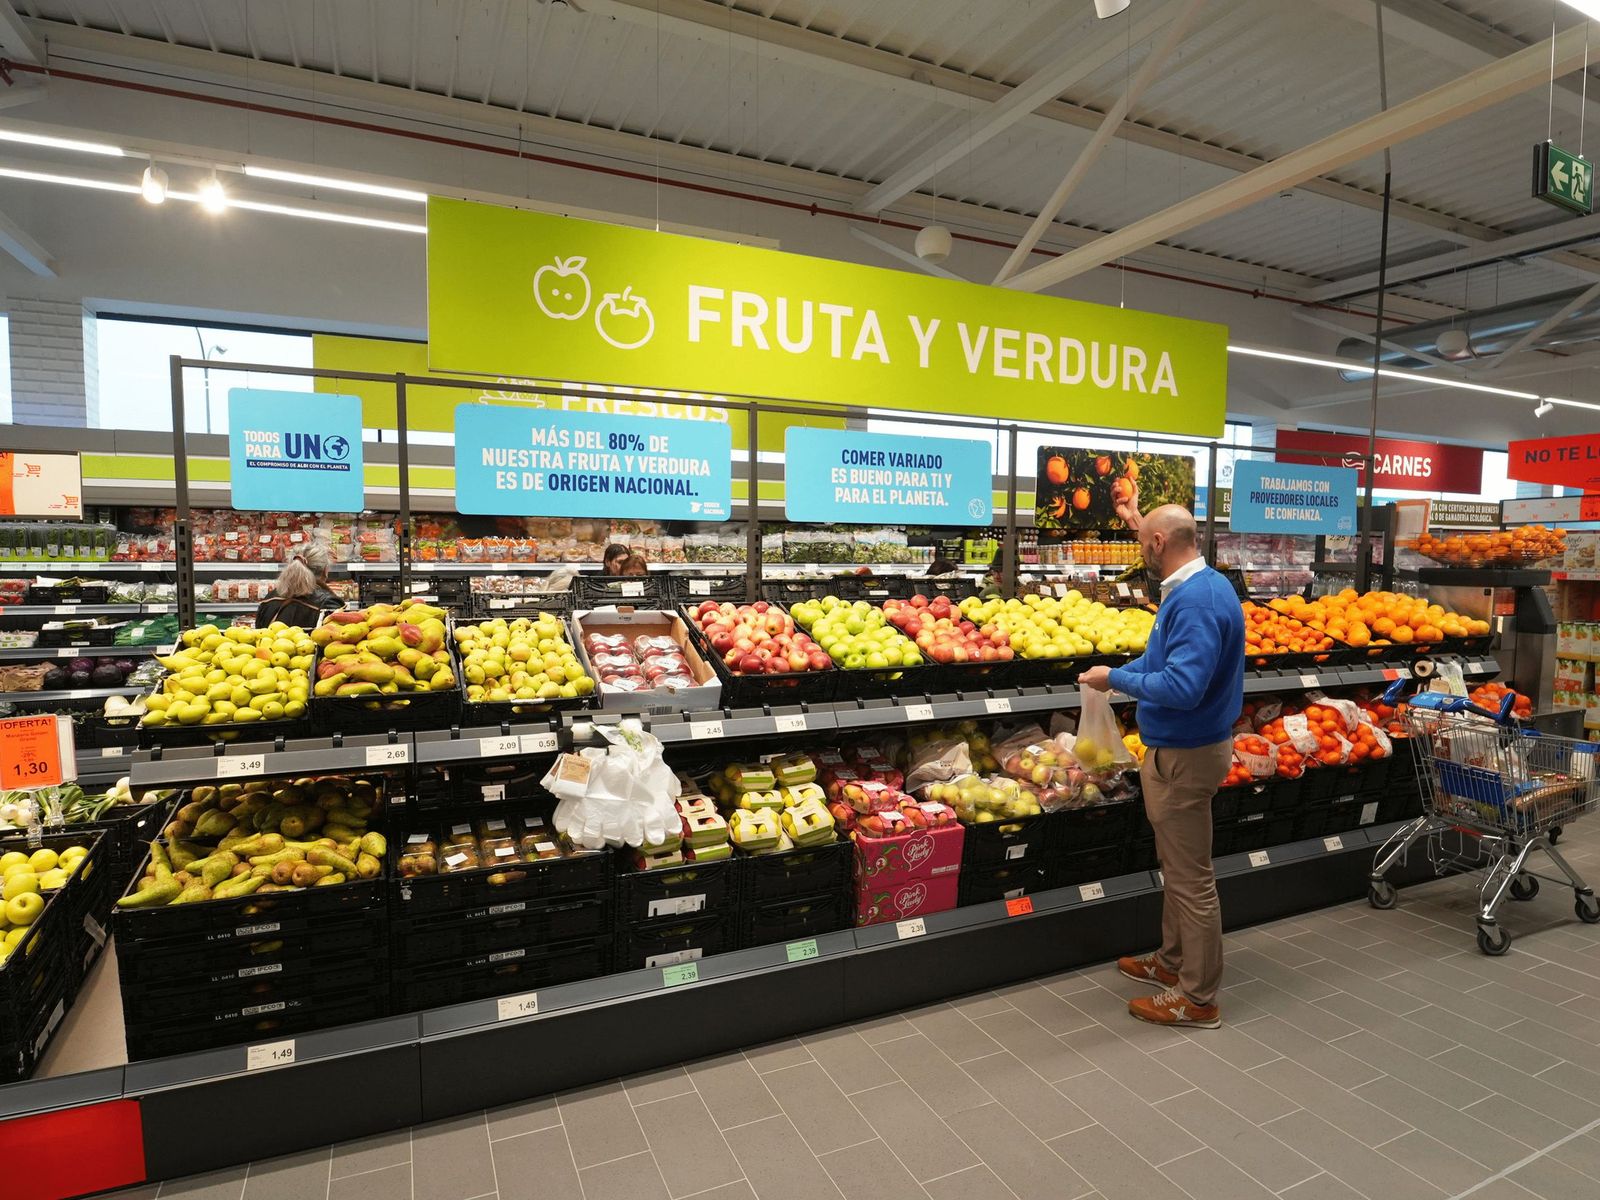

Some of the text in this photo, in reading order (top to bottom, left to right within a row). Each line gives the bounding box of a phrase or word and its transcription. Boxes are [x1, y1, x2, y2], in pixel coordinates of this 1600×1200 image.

[687, 283, 1179, 397] FRUTA Y VERDURA
[561, 381, 729, 422] FRESCOS
[243, 430, 280, 443] TODOS
[531, 425, 669, 453] MÁS DEL 80% DE
[245, 444, 282, 458] PARA
[1525, 445, 1600, 464] NO TE L
[481, 448, 711, 477] NUESTRA FRUTA Y VERDURA
[842, 449, 943, 470] COMER VARIADO
[1373, 453, 1432, 477] CARNES
[496, 471, 699, 496] ES DE ORIGEN NACIONAL.
[831, 467, 952, 489] ES BUENO PARA TI Y
[1260, 476, 1330, 493] TRABAJAMOS CON
[834, 487, 949, 507] PARA EL PLANETA.
[1250, 491, 1339, 508] PROVEEDORES LOCALES
[1264, 507, 1323, 521] DE CONFIANZA.
[1438, 503, 1448, 512] CON
[1448, 503, 1475, 513] CERTIFICADO
[1475, 505, 1481, 513] DE
[1438, 512, 1445, 521] DE
[0, 718, 51, 730] ¡OFERTA!
[707, 727, 722, 735] 2,45
[499, 741, 517, 750] 2,09
[538, 739, 556, 748] 0,59
[387, 750, 406, 759] 2,69
[13, 761, 48, 777] 1,30
[240, 761, 261, 771] 3,49
[907, 839, 929, 856] Pink
[910, 846, 932, 862] Lady
[899, 886, 921, 904] Pink
[901, 894, 924, 911] Lady
[911, 923, 924, 933] 2,39
[802, 946, 817, 956] 2,39
[681, 971, 696, 980] 2,39
[518, 1000, 536, 1011] 1,49
[272, 1048, 293, 1060] 1,49
